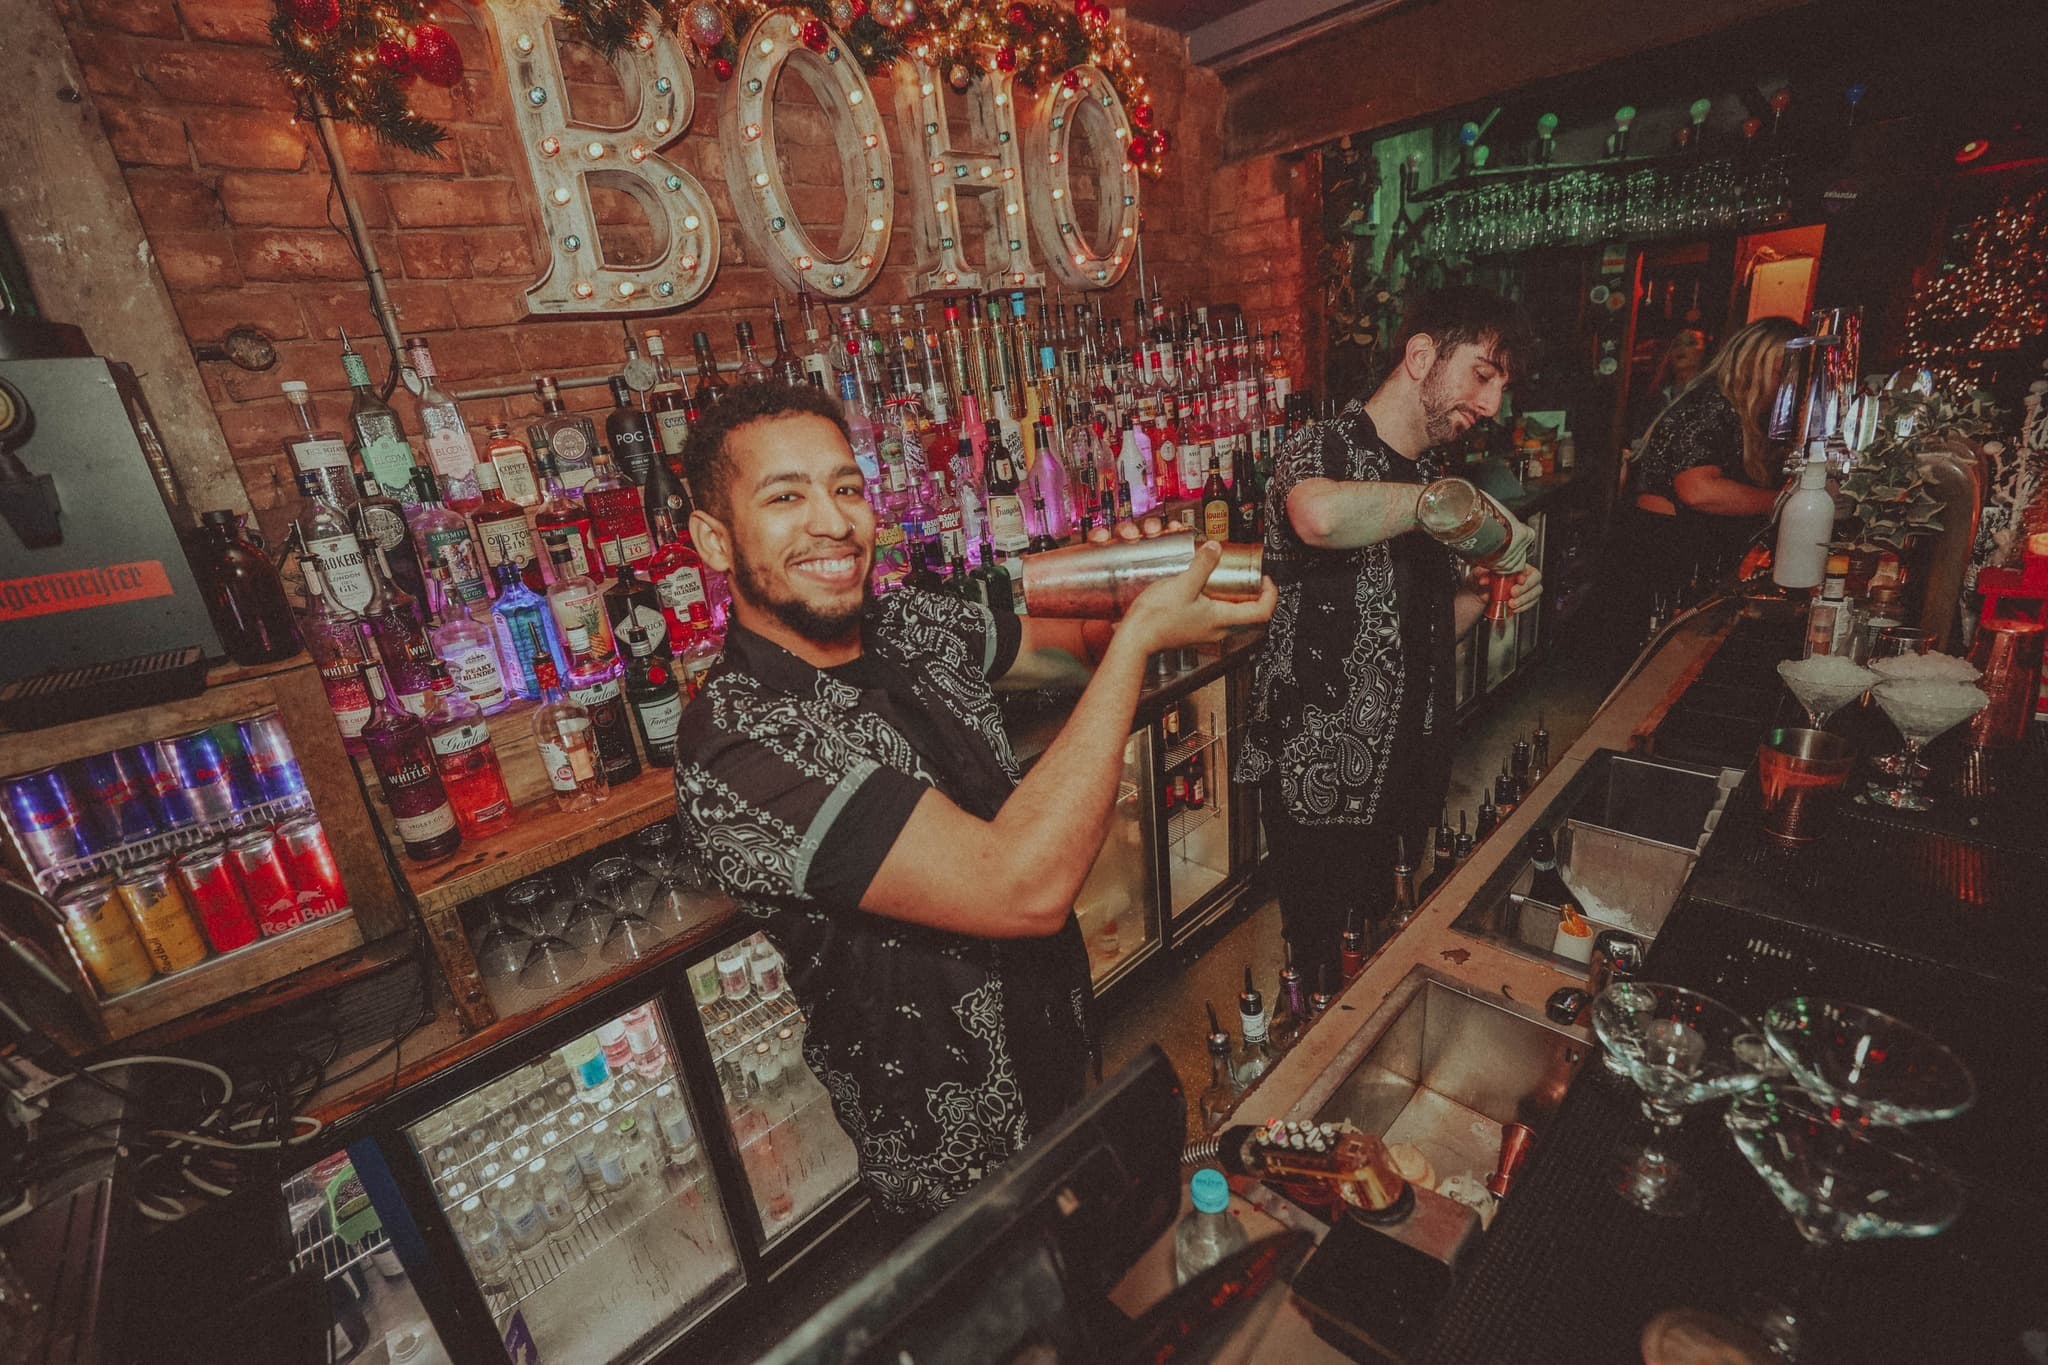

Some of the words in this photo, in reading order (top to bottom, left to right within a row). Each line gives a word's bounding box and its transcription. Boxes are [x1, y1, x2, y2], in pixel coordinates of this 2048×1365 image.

[484, 0, 1142, 315] BOHO
[941, 519, 959, 529] JUICE
[431, 529, 466, 542] SIPSMIT
[339, 584, 358, 593] GIN
[464, 663, 492, 675] PEAKY
[388, 764, 432, 785] WHITLEY
[261, 911, 302, 937] Red
[301, 898, 337, 922] Bull
